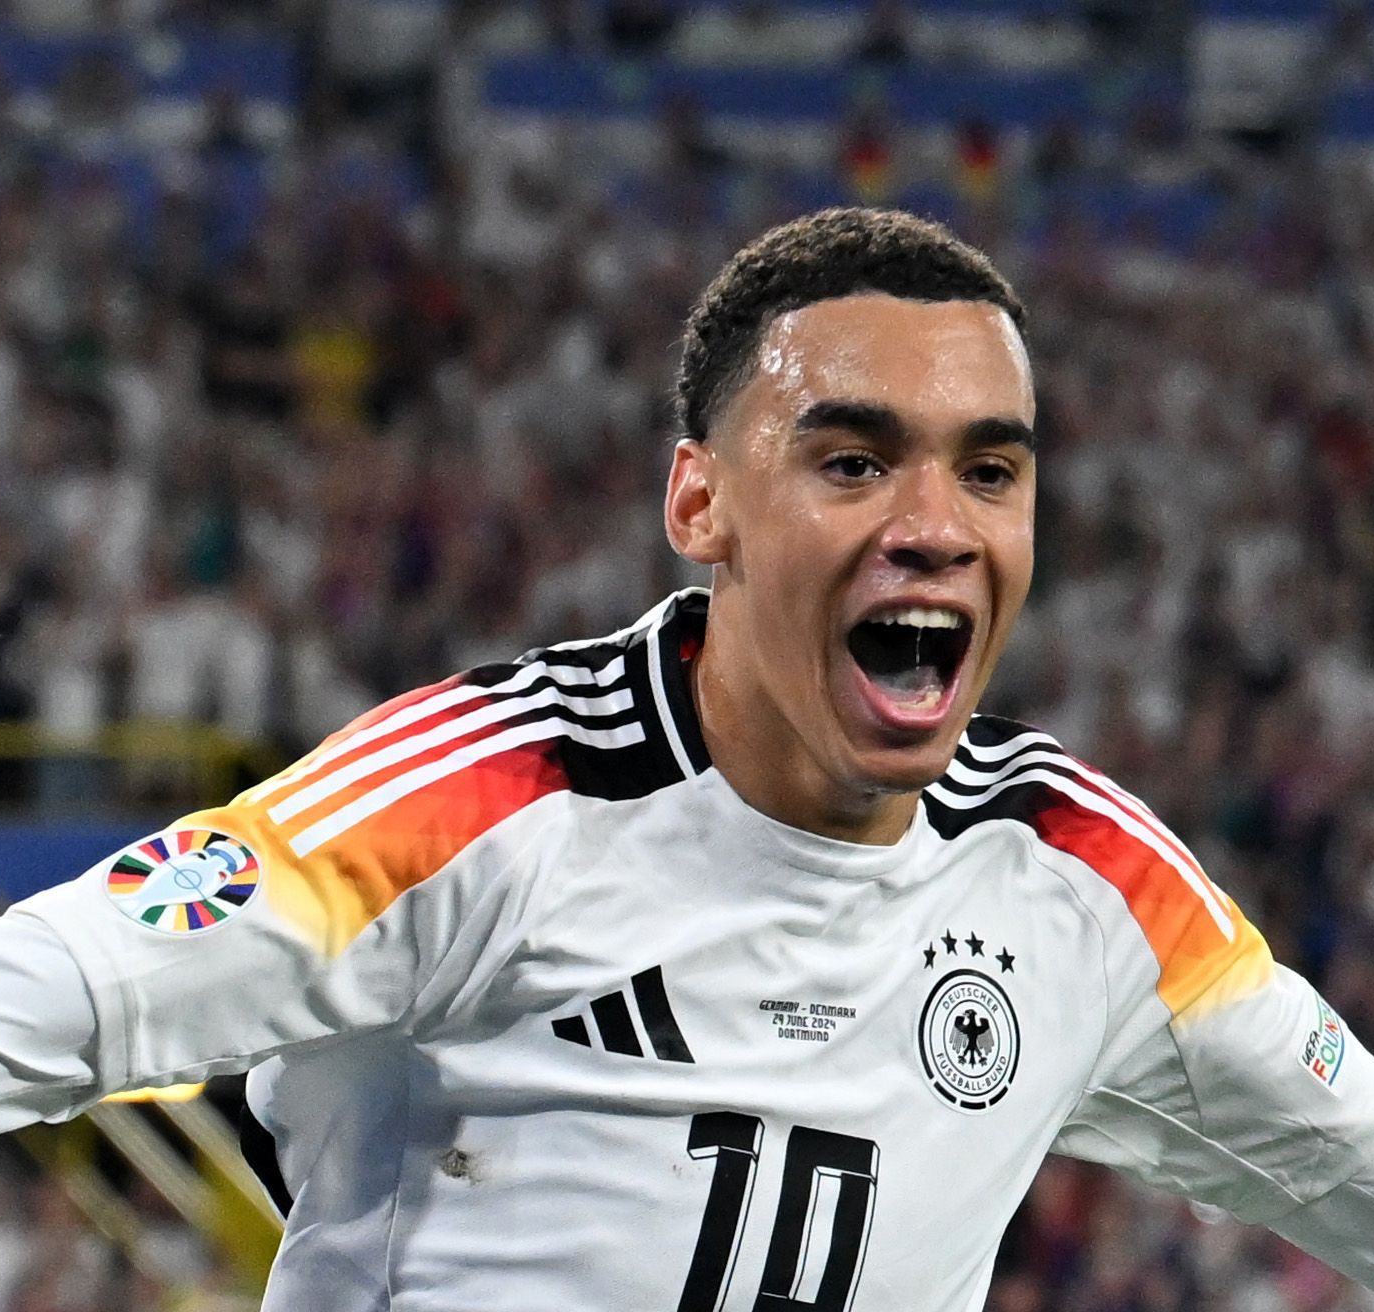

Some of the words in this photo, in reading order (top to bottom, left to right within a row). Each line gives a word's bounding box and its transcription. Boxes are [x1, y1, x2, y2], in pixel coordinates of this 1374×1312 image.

[758, 999, 800, 1014] GERMANY
[809, 1003, 857, 1019] DENMARK
[942, 987, 999, 1014] DEUTSCHER
[772, 1012, 785, 1026] 29
[785, 1014, 809, 1028] JUNE
[811, 1017, 837, 1030] 2024
[777, 1027, 830, 1042] DORTMUND
[1302, 1029, 1321, 1067] UEFA
[935, 1051, 1008, 1091] FUSSBALL-BUND
